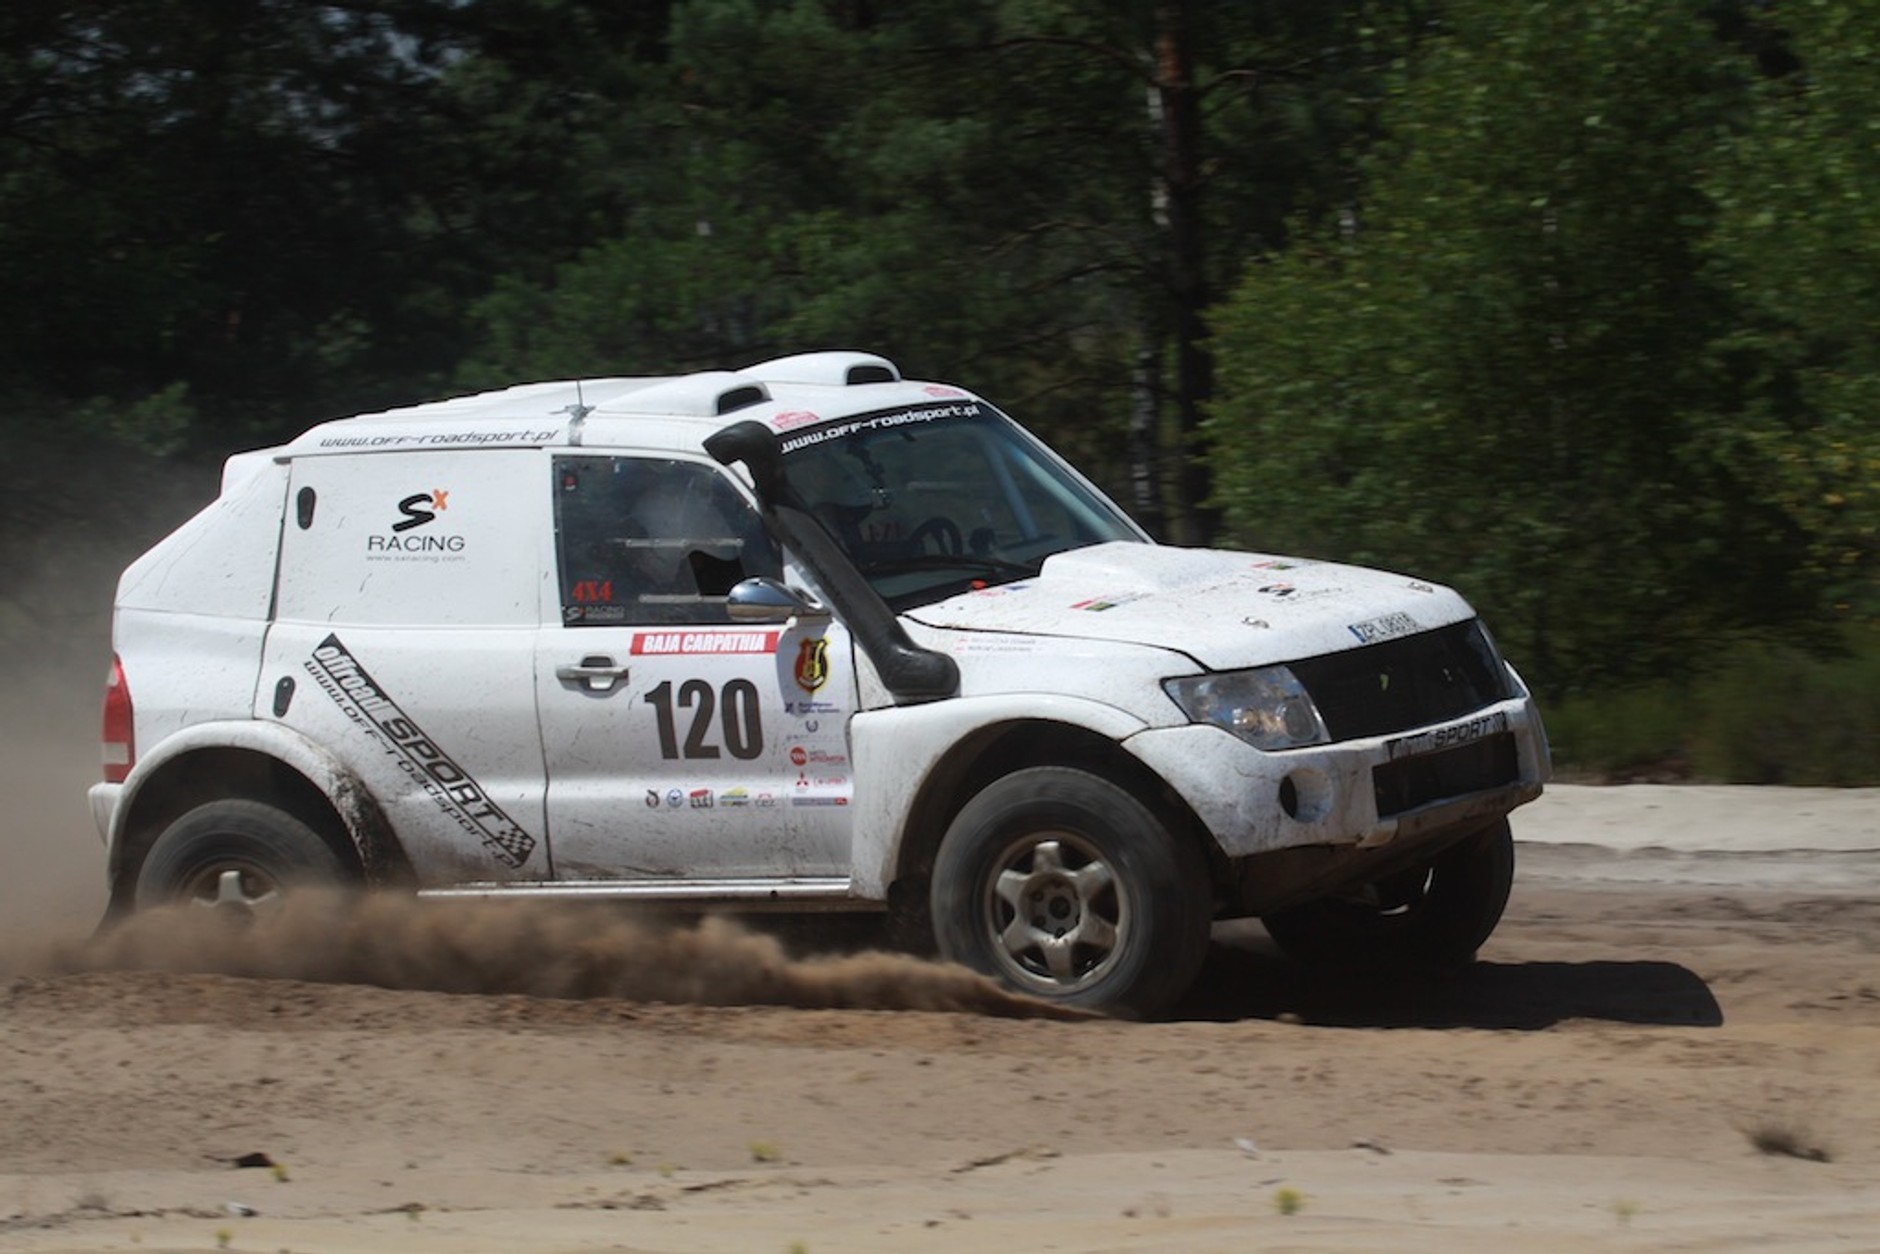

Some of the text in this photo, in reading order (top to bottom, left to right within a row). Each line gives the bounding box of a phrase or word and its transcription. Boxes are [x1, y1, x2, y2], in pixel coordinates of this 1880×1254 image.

[367, 535, 465, 551] RACING
[642, 632, 766, 653] BAJA CARPATHIA
[644, 678, 764, 760] 120
[381, 717, 504, 822] SPORT
